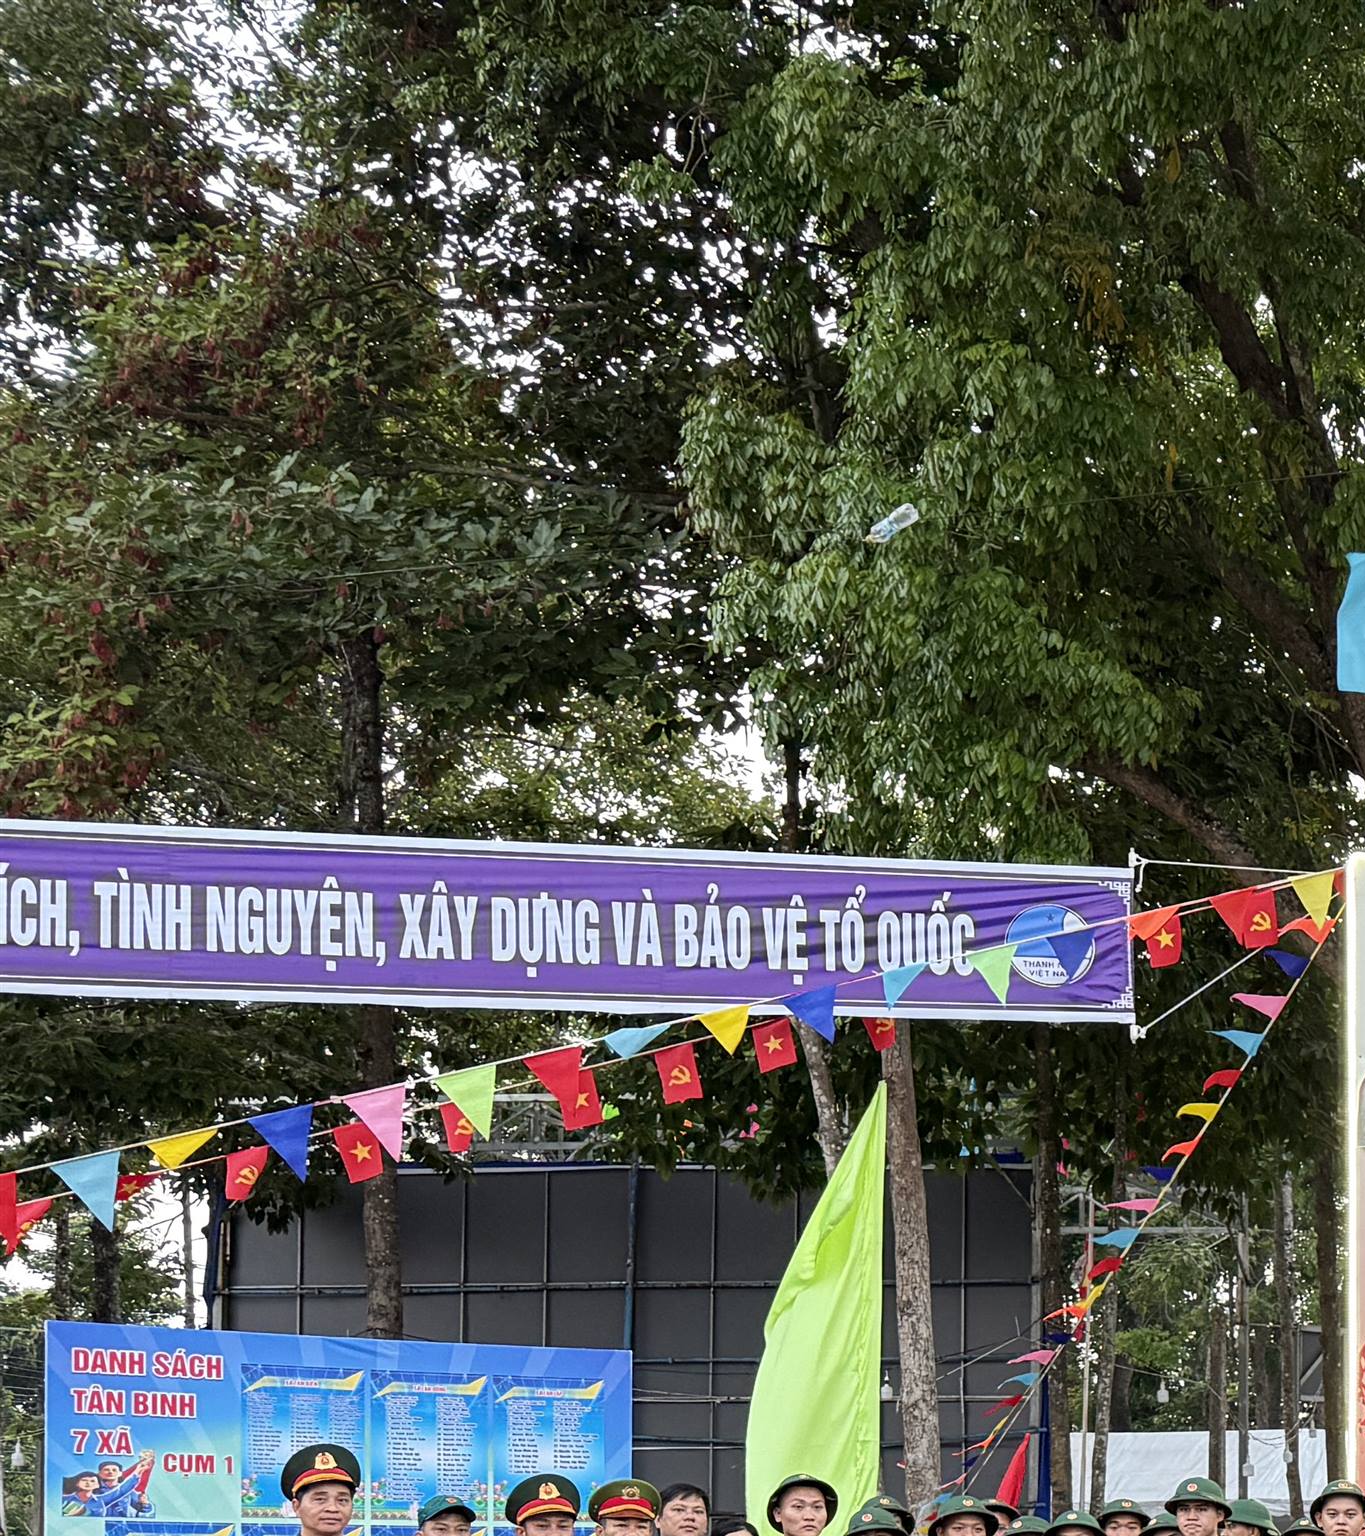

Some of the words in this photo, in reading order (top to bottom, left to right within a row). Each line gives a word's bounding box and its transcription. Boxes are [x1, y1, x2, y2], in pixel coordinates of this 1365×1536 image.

[94, 867, 191, 951] TÌNH
[206, 876, 386, 971] NGUYỆN,
[399, 880, 478, 960] XÂY
[492, 891, 599, 977] DỰNG
[612, 888, 664, 967] VÀ
[675, 883, 750, 970] BẢO
[762, 893, 808, 985] VỆ
[819, 885, 866, 973] TỔ
[878, 892, 975, 976] QUỐC
[1023, 960, 1053, 968] THANH
[72, 1348, 145, 1375] DANH
[154, 1349, 223, 1379] SÁCH
[72, 1385, 124, 1414] TÂN
[133, 1392, 195, 1417] BINH
[72, 1430, 88, 1453] 7
[97, 1427, 132, 1454] XÃ
[163, 1453, 215, 1477] CỤM
[224, 1456, 233, 1474] 1
